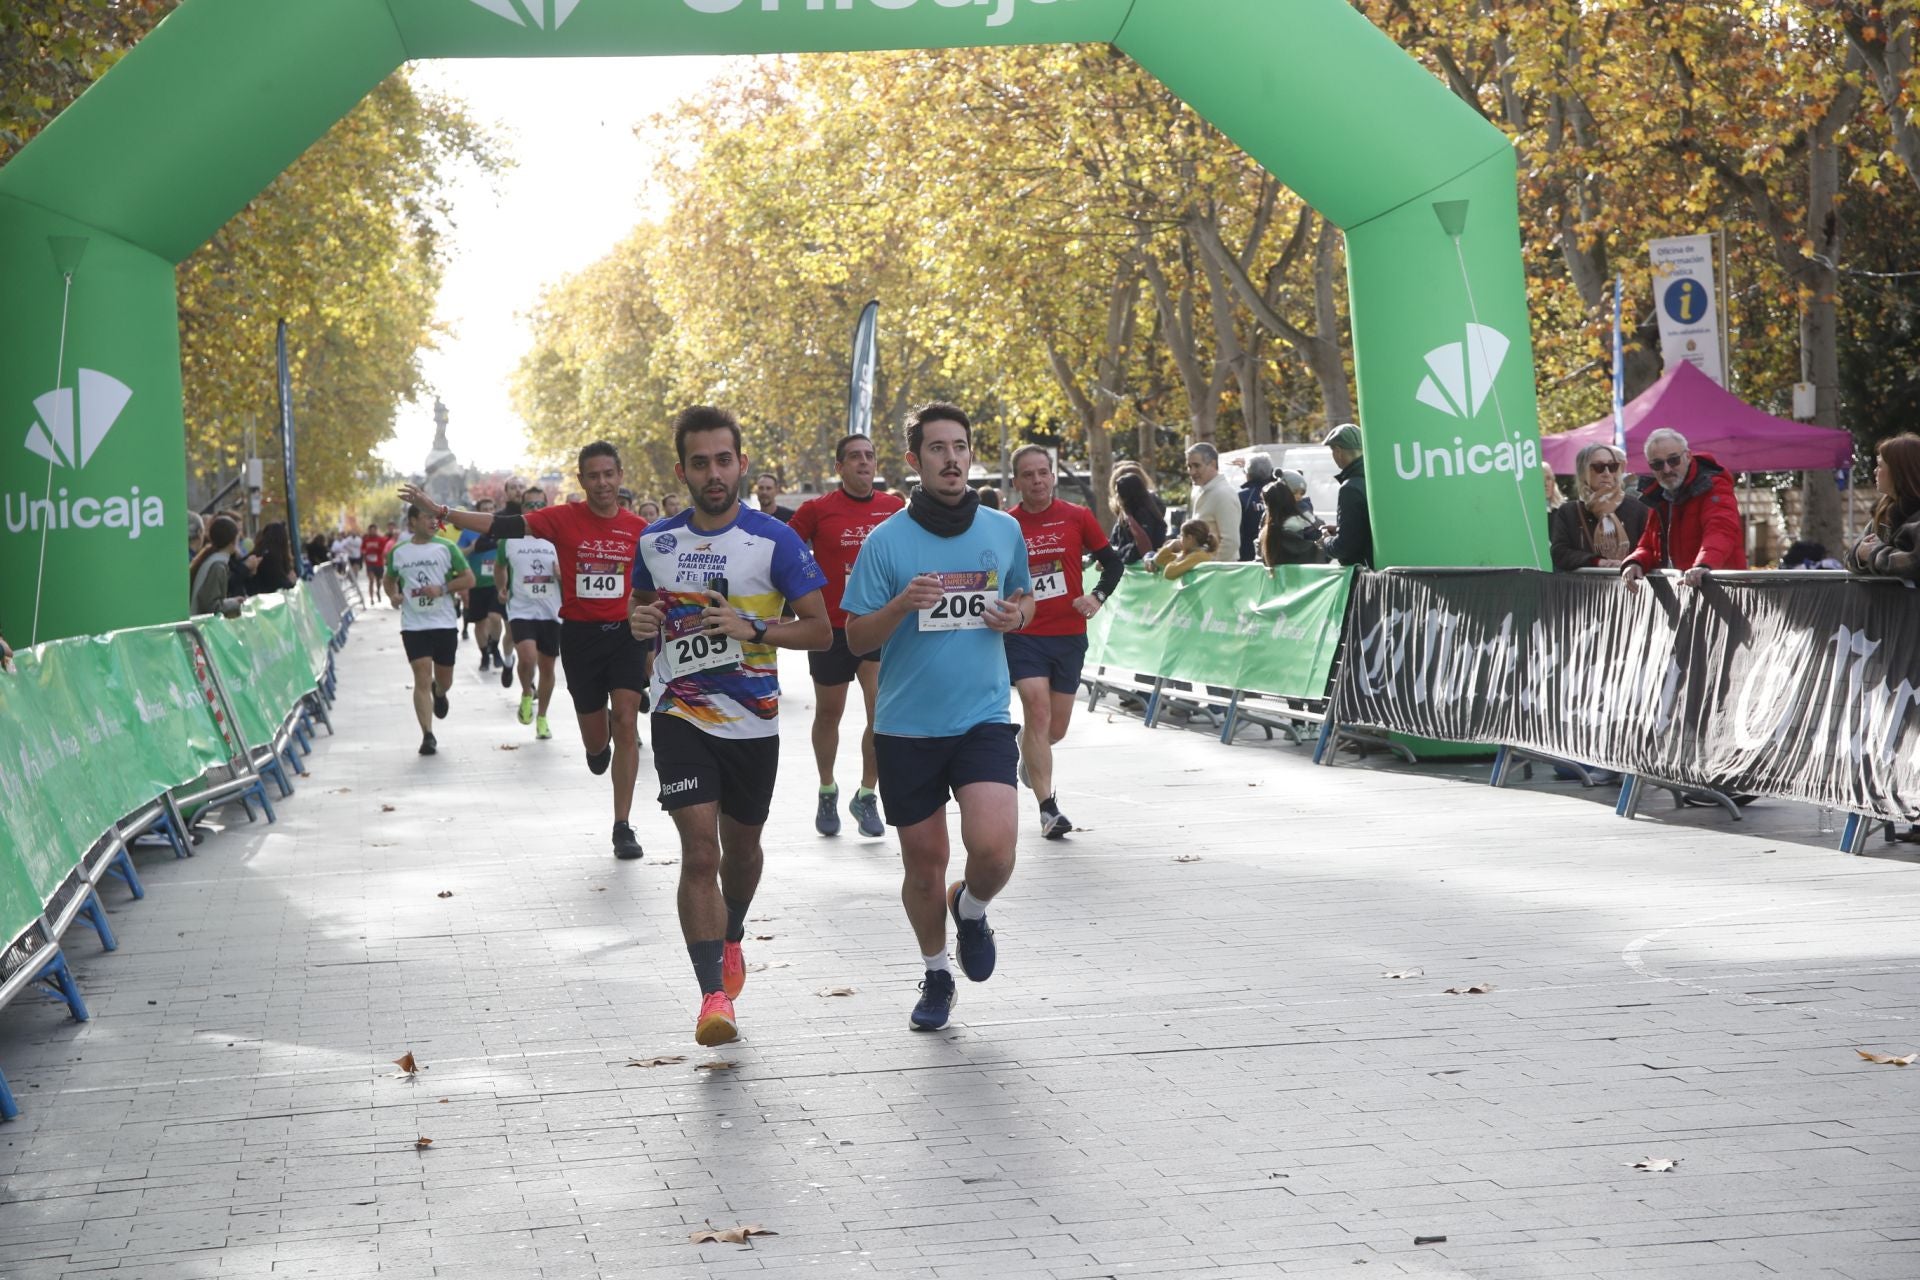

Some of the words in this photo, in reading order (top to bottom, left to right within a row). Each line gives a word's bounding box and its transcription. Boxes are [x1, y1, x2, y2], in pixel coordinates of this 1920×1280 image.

[1394, 431, 1537, 481] Unicaja
[5, 485, 164, 539] Unicaja
[841, 539, 859, 547] Sports
[577, 550, 595, 559] Sports
[604, 553, 633, 562] Santander
[1036, 547, 1066, 555] Santander
[678, 553, 727, 564] CARREIRA
[532, 584, 547, 594] 84
[583, 576, 616, 591] 140
[418, 597, 434, 607] 82
[930, 594, 985, 618] 206
[676, 635, 728, 664] 205
[662, 776, 698, 796] Recalvi
